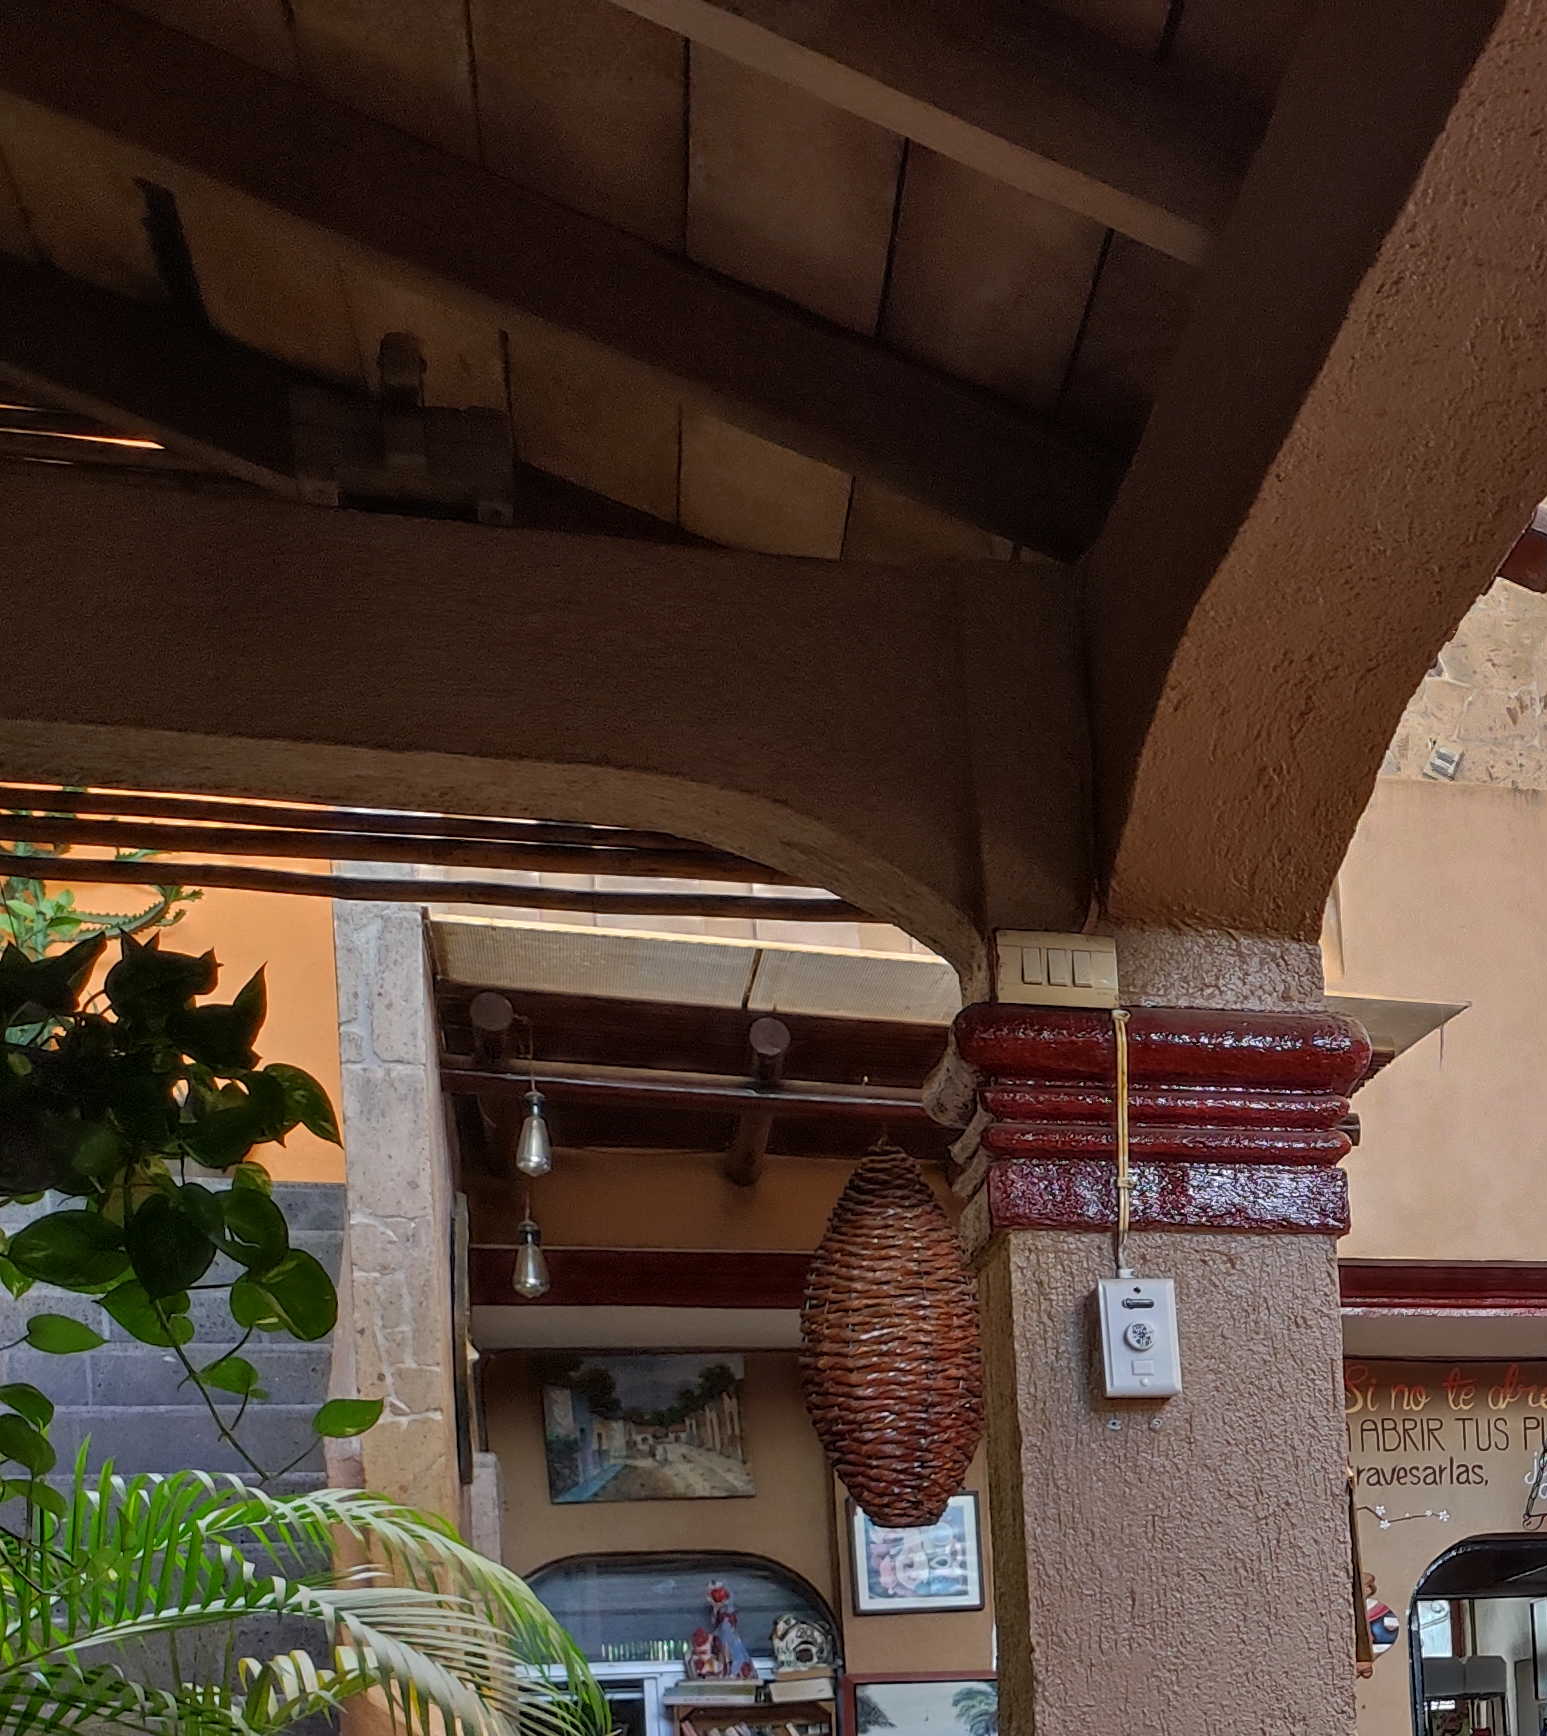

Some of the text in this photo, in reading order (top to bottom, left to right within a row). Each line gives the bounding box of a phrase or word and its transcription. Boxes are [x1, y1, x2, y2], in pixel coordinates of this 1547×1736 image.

[1345, 1365, 1379, 1413] Si
[1391, 1384, 1432, 1411] no
[1442, 1367, 1478, 1411] te
[1360, 1417, 1445, 1452] ABRIR
[1455, 1417, 1509, 1451] TUS
